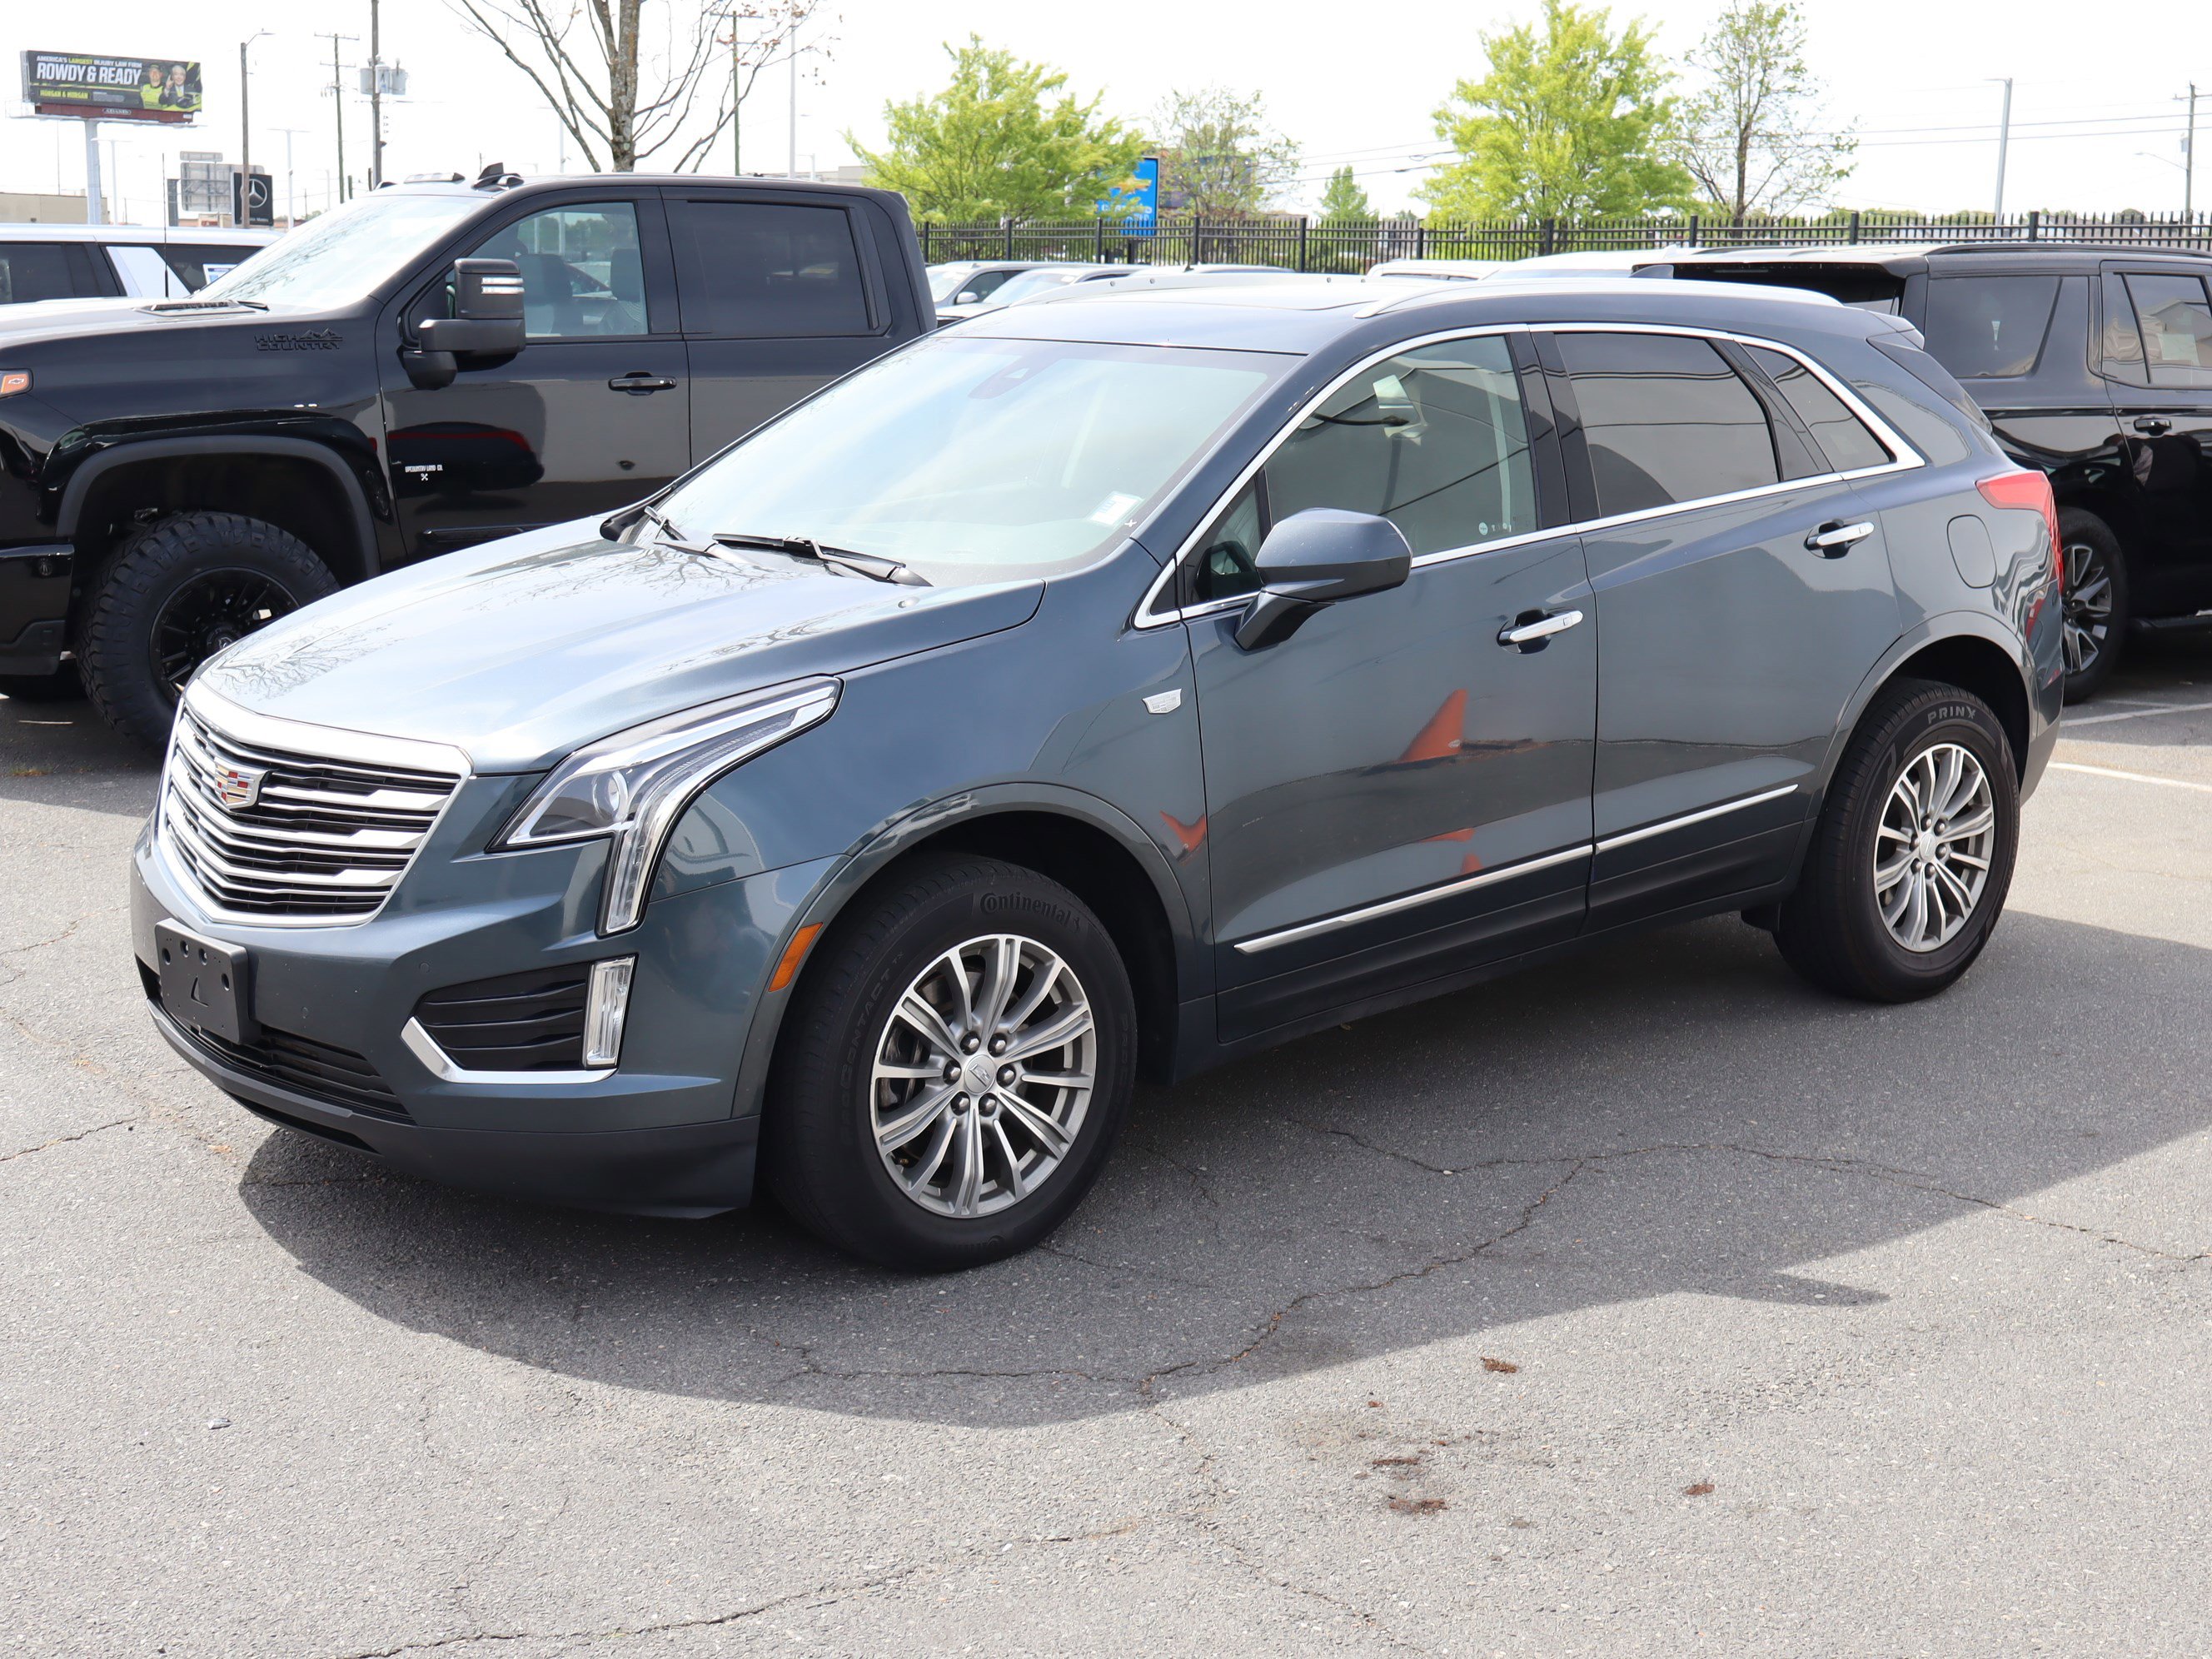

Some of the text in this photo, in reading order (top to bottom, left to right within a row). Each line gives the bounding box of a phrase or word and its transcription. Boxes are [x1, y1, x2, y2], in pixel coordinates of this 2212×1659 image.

[37, 62, 142, 85] ROWDY & READY
[254, 333, 300, 343] HIGH
[257, 342, 340, 351] COUNTRY
[1927, 705, 1976, 725] PRINX
[979, 891, 1072, 928] Continental
